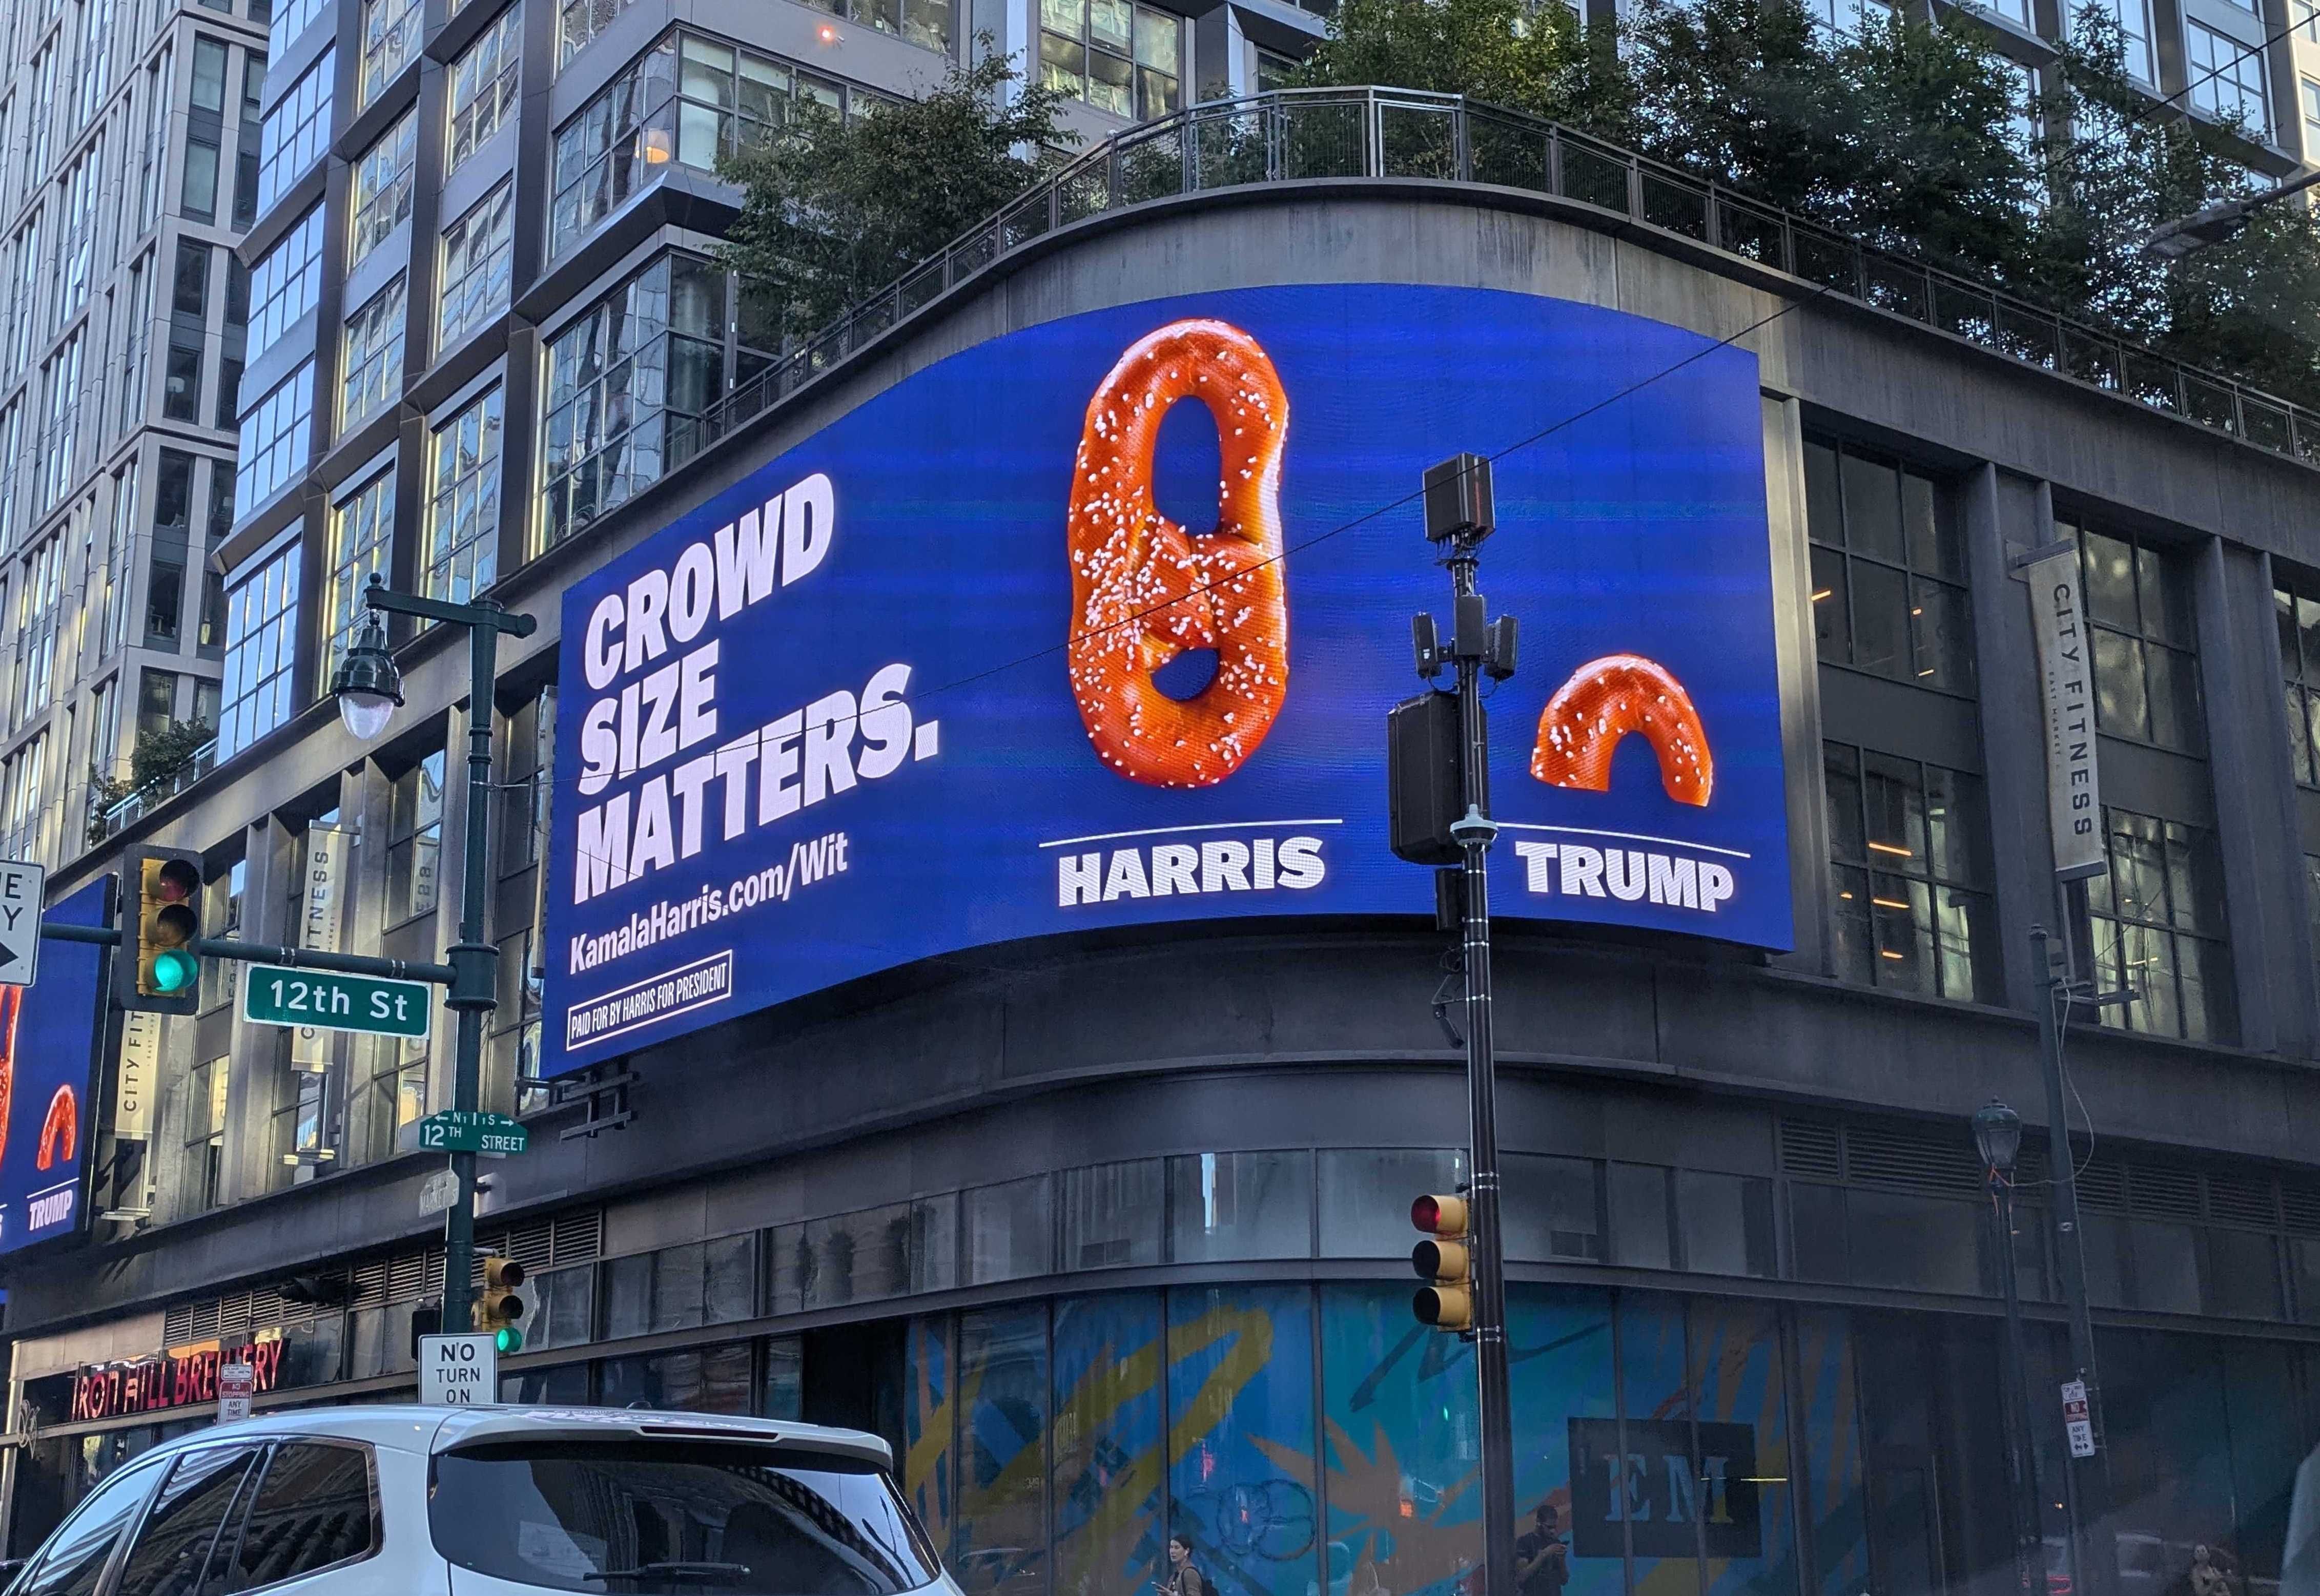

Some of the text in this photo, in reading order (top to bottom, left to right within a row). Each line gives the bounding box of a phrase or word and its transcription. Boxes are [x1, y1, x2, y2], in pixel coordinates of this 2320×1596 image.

[585, 473, 834, 690] CROWD
[578, 638, 718, 795] SIZE
[2054, 583, 2092, 836] CITY FITNESS
[574, 663, 938, 905] MATTERS.
[306, 851, 329, 949] ITNESS
[570, 832, 849, 975] KamalaHarris.com/Wit
[1058, 836, 1326, 907] HARRIS
[1515, 840, 1734, 912] TRUMP
[271, 979, 407, 1021] 12th St
[571, 962, 727, 1040] PAID FOR BY HARRIS FOR PRESIDENT
[124, 1058, 139, 1112] CITY
[481, 1135, 524, 1151] STREET
[29, 1189, 73, 1231] TRUMP
[436, 1367, 480, 1383] TURN
[441, 1343, 475, 1362] NO
[446, 1388, 470, 1403] ON
